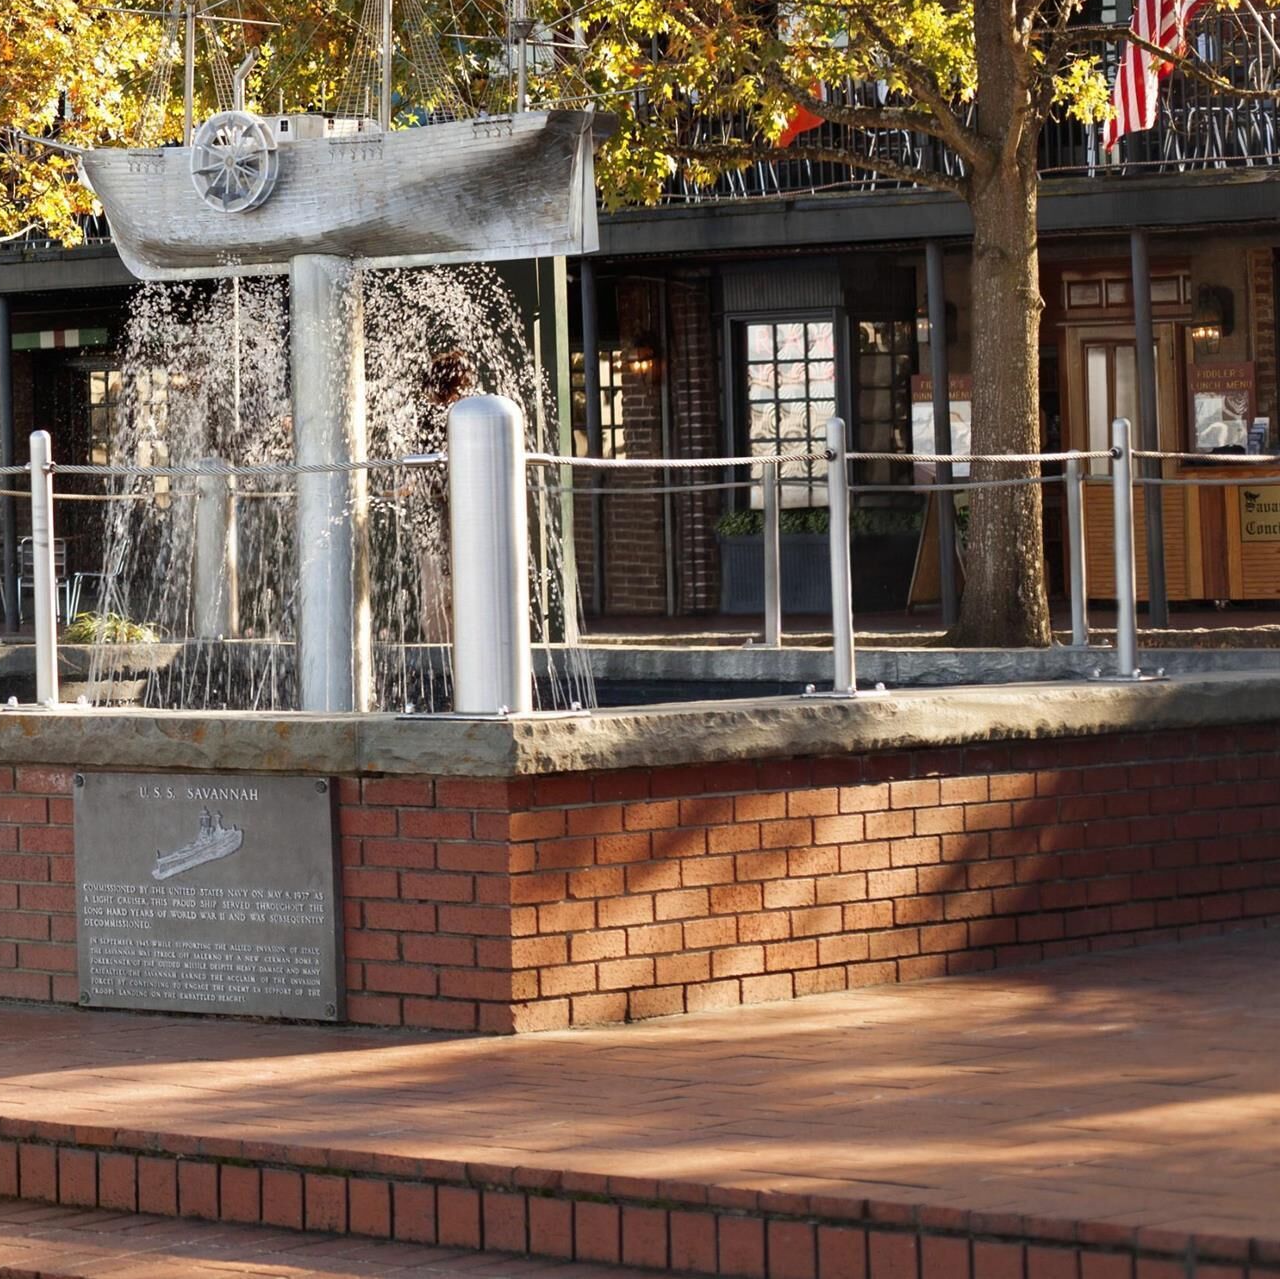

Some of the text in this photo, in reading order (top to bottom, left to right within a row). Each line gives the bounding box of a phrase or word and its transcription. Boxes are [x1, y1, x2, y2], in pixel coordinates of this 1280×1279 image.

[1226, 380, 1253, 390] MENU
[1246, 502, 1280, 512] Sava
[139, 786, 149, 798] U.
[154, 786, 162, 799] S.
[186, 787, 258, 801] SAVANNAH
[82, 883, 136, 894] COMMISSIONED
[139, 885, 147, 894] BY
[152, 885, 165, 895] THE
[168, 886, 195, 896] UNITED
[199, 887, 223, 897] STATES
[227, 888, 248, 898] NAVY
[251, 889, 263, 898] ON
[267, 889, 282, 899] MAY
[314, 891, 323, 901] AS
[83, 895, 324, 912] A LIGHT THIS PROUD SHIP SERVED THROUGHOUT THE
[83, 906, 103, 915] LONG
[106, 907, 127, 916] HARD
[130, 908, 154, 917] YEARS
[157, 909, 166, 918] OF
[169, 909, 196, 919] WORLD
[200, 910, 217, 920] WAR
[228, 912, 246, 921] AND
[249, 912, 265, 922] WAS
[270, 913, 324, 924] SUBSEQUENTLY
